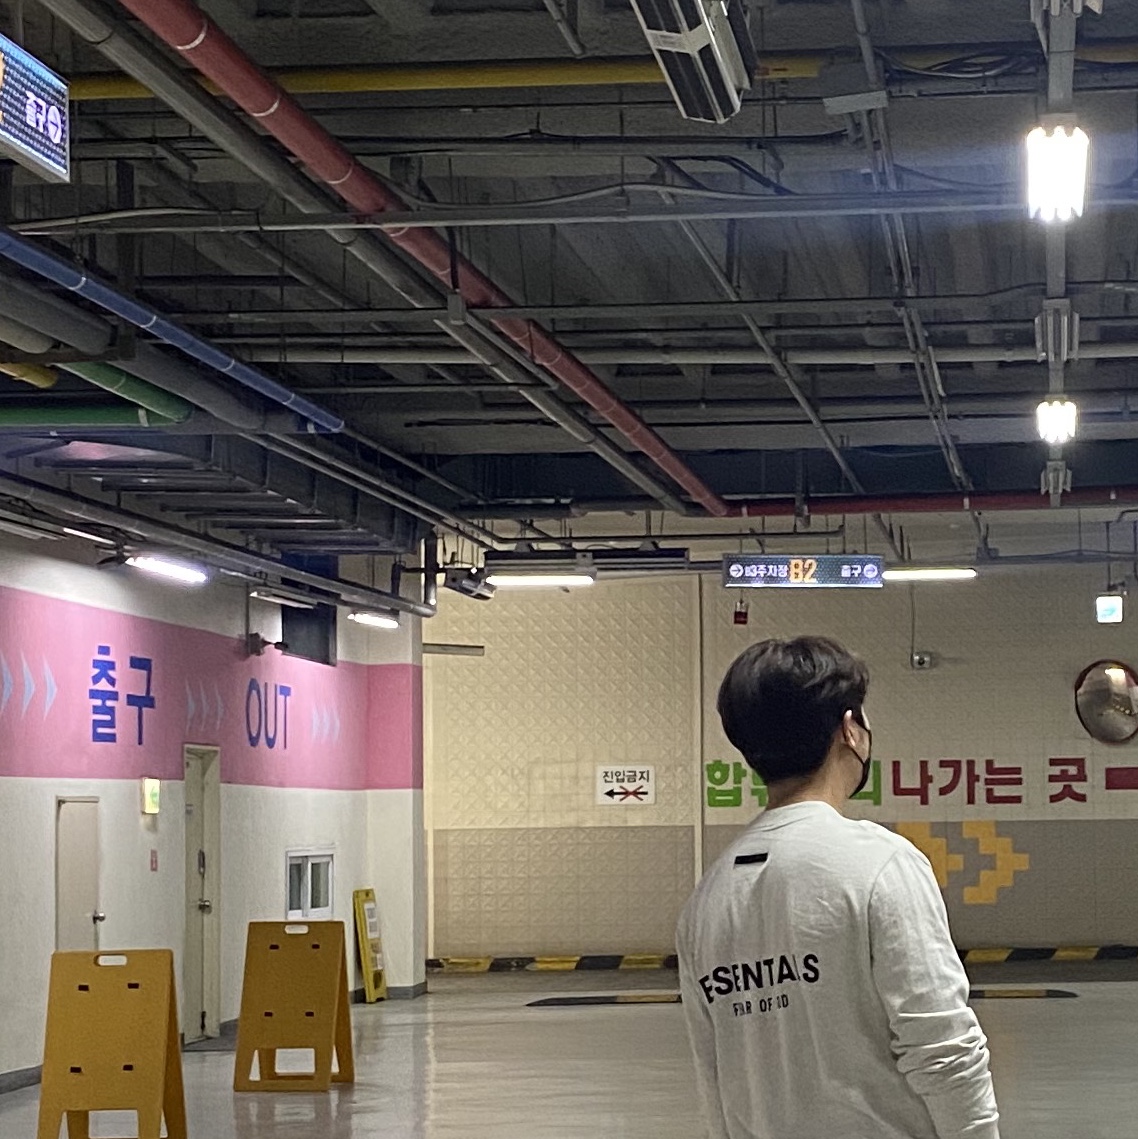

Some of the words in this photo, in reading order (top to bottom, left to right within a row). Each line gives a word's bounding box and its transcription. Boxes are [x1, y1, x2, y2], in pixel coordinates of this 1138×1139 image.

[789, 559, 818, 583] B2
[841, 564, 862, 578] 출구
[88, 645, 156, 746] 출구
[246, 678, 292, 749] OUT
[602, 769, 650, 784] 진입금지
[892, 759, 1023, 805] 나가는
[1048, 757, 1088, 803] 곳
